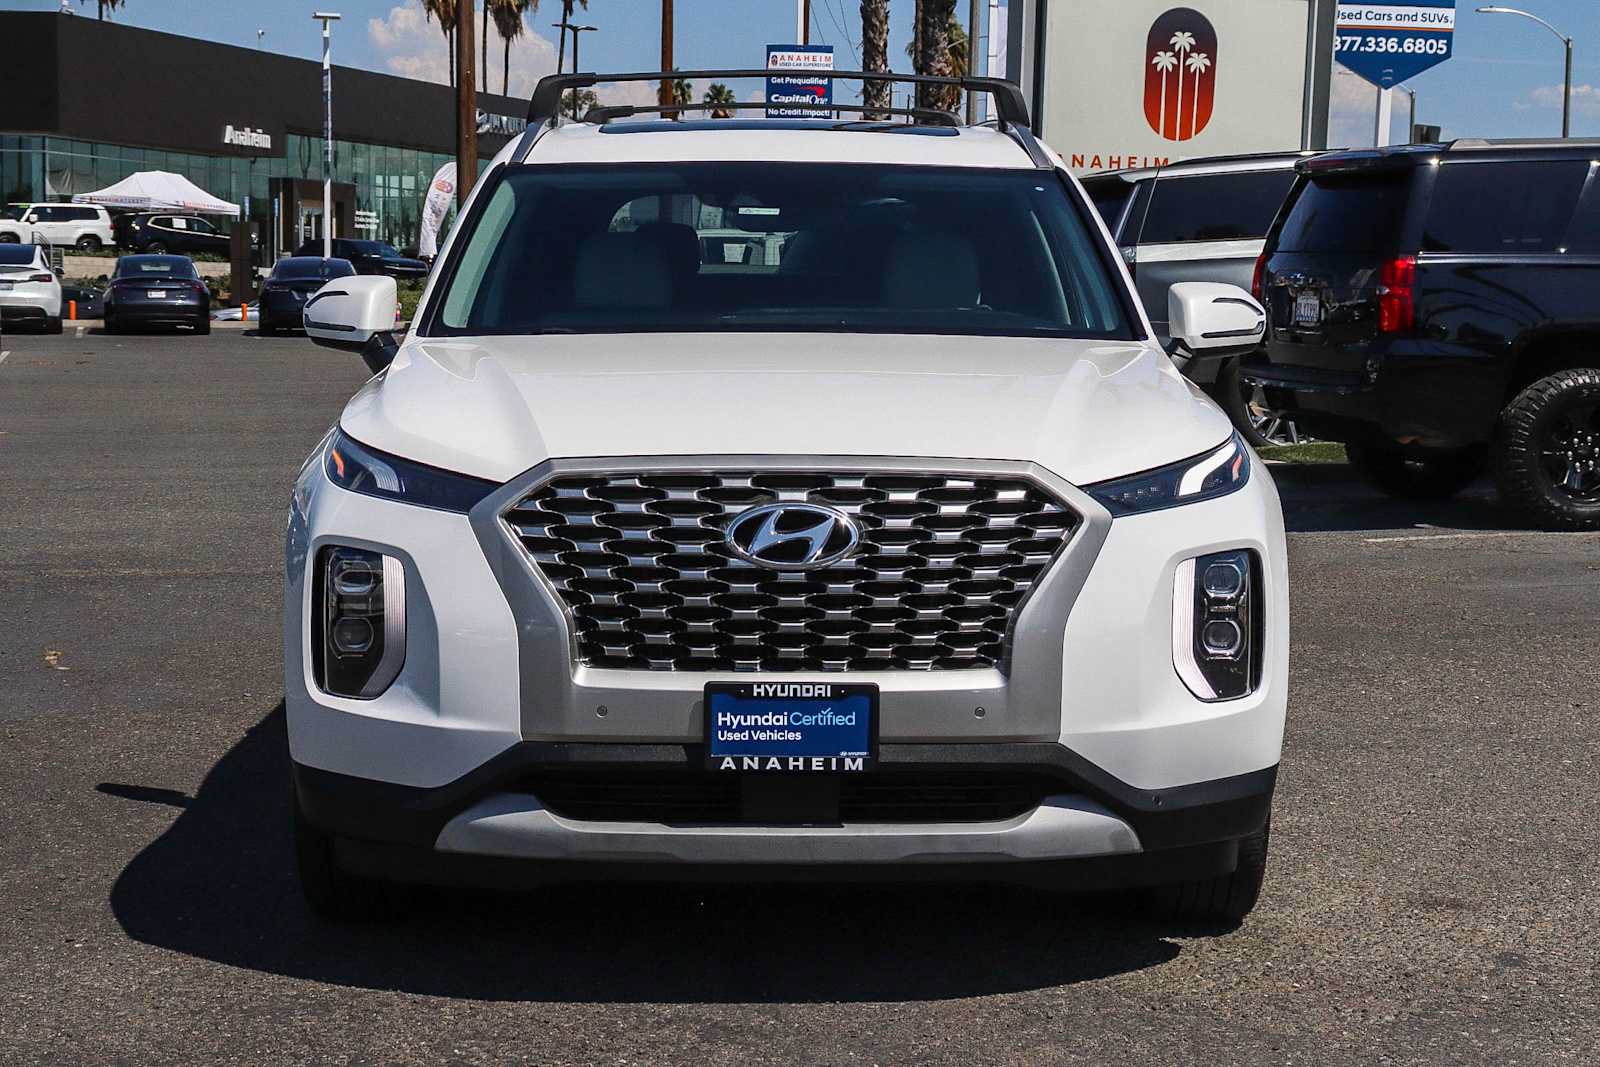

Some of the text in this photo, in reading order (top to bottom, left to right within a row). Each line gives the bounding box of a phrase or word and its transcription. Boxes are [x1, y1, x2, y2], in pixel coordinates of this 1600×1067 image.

[1365, 10, 1392, 21] Cars
[1395, 11, 1418, 22] and
[785, 77, 828, 85] Prequalified
[780, 108, 802, 116] Credit
[803, 109, 830, 117] Impact!
[224, 125, 271, 149] Anaheim
[1057, 154, 1169, 169] NAHEIM
[753, 685, 831, 697] HYUNDAI
[718, 707, 856, 729] Hyundai Certified
[718, 730, 802, 741] Used Vehicles
[720, 757, 863, 770] ANAHEIM
